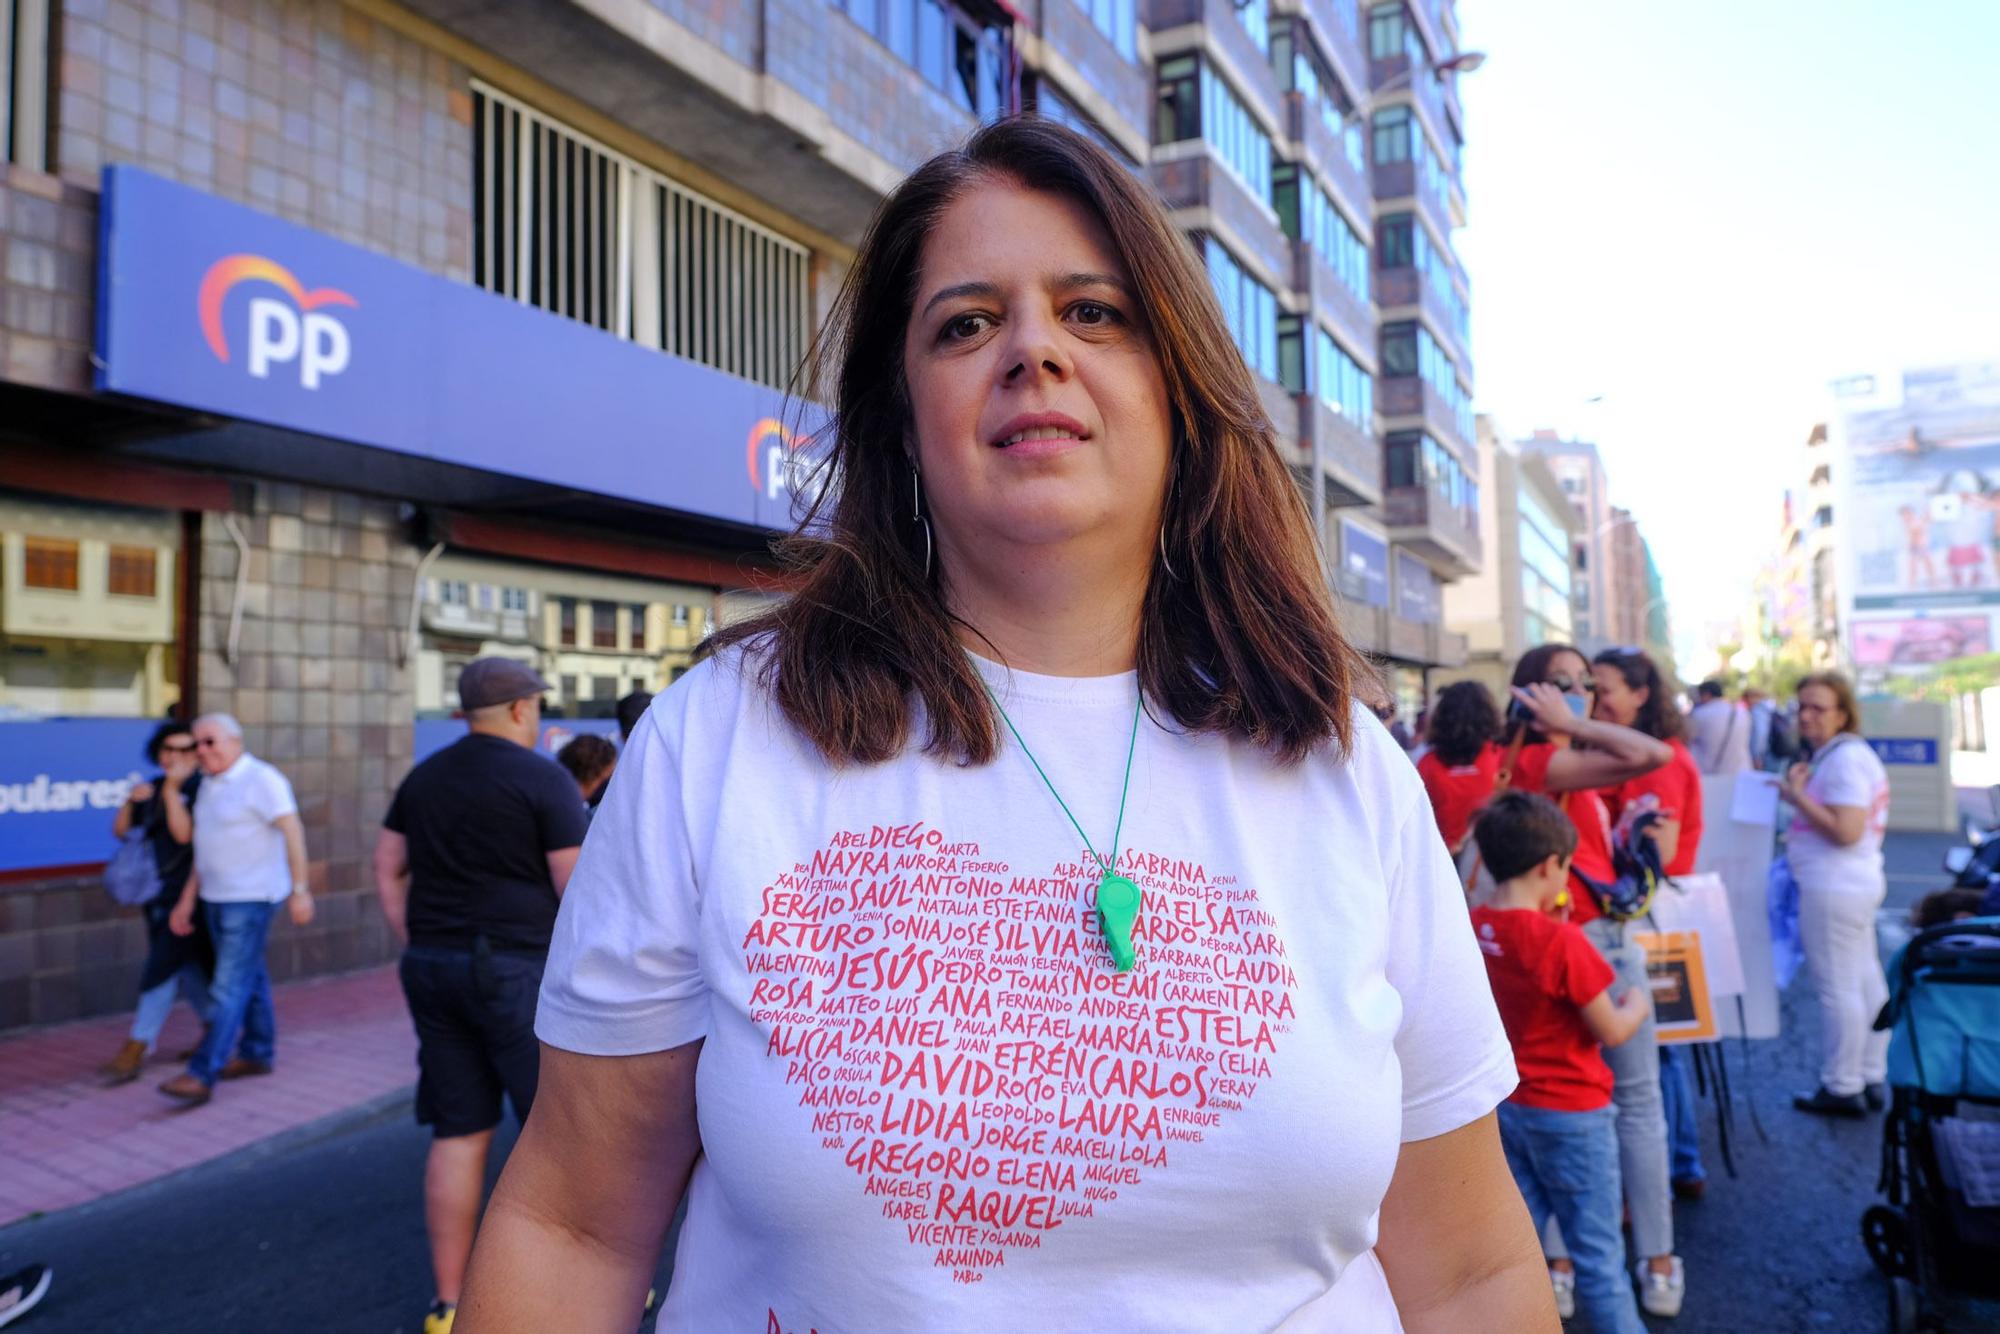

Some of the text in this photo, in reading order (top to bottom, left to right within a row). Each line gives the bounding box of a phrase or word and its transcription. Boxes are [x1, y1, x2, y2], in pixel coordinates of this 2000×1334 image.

[829, 821, 943, 850] ABEL DIEGO
[936, 843, 980, 856] MARTA
[794, 849, 1009, 878] BEA NAYRA AURORA FEDERICO
[1126, 848, 1207, 884] SABRINA
[775, 873, 809, 891] XAVI
[848, 873, 913, 912] SAÚL
[910, 874, 1003, 899] ANTONIO
[1009, 876, 1079, 902] MARTÍN
[1053, 863, 1084, 879] ALBA
[1141, 875, 1168, 892] CÉSAR
[1169, 881, 1223, 903] ADOLFO
[1211, 875, 1237, 885] XENIA
[760, 886, 845, 922] SERGIO
[1226, 889, 1259, 902] PILAR
[852, 911, 884, 923] YLENIA
[917, 898, 978, 916] NATALIA
[983, 898, 1076, 924] ESTEFANÍA
[1173, 901, 1278, 935] ELSA TANIA
[742, 919, 875, 952] ARTURO
[883, 913, 940, 941] SONIA
[939, 920, 988, 946] JOSÉ
[995, 919, 1079, 957] SILVIA
[1200, 931, 1287, 959] DÉBORA SARA
[746, 953, 835, 978] VALENTINA
[822, 943, 934, 994] JESÚS
[931, 959, 1002, 985] PEDRO
[1073, 965, 1160, 1000] NOEMÍ
[941, 946, 1076, 974] JAVIER RAMÓN SELENA
[1150, 946, 1212, 970] BÁRBARA
[1165, 954, 1298, 990] ALBERTO CLAUDIA
[749, 978, 1150, 1021] ROSA MATEO LUIS ANA FERNANDO ANDREA
[1162, 982, 1296, 1019] CARMEN TARA
[750, 1008, 815, 1026] LEONARDO
[767, 1004, 1276, 1062] ALICIA DANIEL PAULA RAFAEL MARÍA ESTELA
[843, 1047, 881, 1066] ÓSCAR
[954, 1037, 1088, 1080] JUAN EFRÉN
[1156, 1040, 1272, 1078] ÁLVARO CELIA
[786, 1061, 831, 1086] PACO
[880, 1050, 994, 1097] DAVID
[996, 1074, 1055, 1105] ROCÍO
[1061, 1080, 1087, 1096] EVA
[1089, 1054, 1208, 1109] CARLOS
[1210, 1077, 1257, 1099] YERAY
[799, 1085, 1221, 1143] MANOLO LIDIA LEOPOLDO LAURA ENRIQUE
[1208, 1097, 1242, 1111] GLORIA
[811, 1109, 875, 1134] NÉSTOR
[1166, 1126, 1205, 1143] SAMUEL
[822, 1136, 846, 1149] RAÚL
[971, 1122, 1047, 1155] JORGE
[1051, 1136, 1168, 1169] ARACELI LOLA
[845, 1137, 1076, 1193] GREGORIO ELENA
[1082, 1163, 1142, 1185] MIGUEL
[864, 1174, 932, 1200] ÁNGELES
[1083, 1186, 1118, 1202] HUGO
[882, 1182, 1094, 1230] ISABEL RAQUEL JULIA
[907, 1223, 1041, 1249] VICENTE YOLANDA
[934, 1247, 1004, 1268] ARMINDA
[953, 1269, 983, 1285] PABLO
